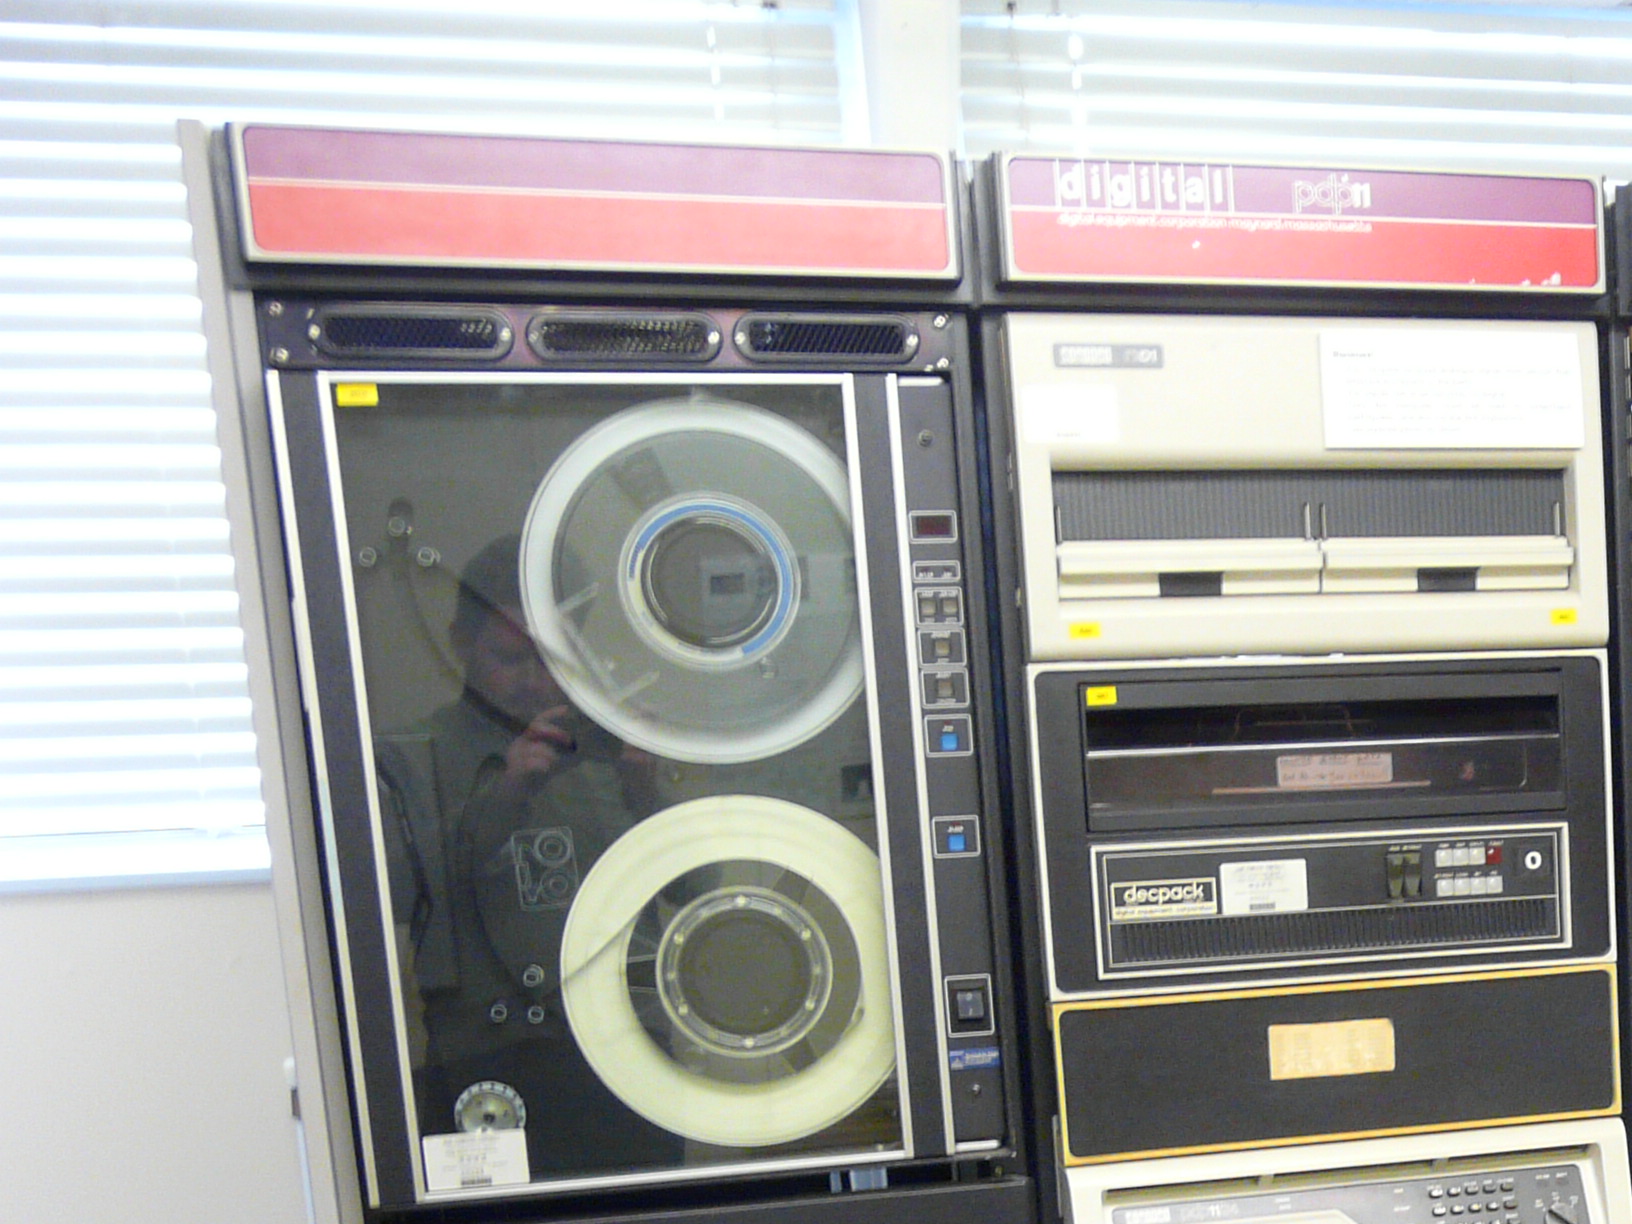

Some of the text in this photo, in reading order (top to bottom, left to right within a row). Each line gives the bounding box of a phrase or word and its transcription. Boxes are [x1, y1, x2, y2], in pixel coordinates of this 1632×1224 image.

[1058, 163, 1225, 207] digital
[1524, 850, 1543, 870] 0
[1123, 881, 1205, 905] decpack
